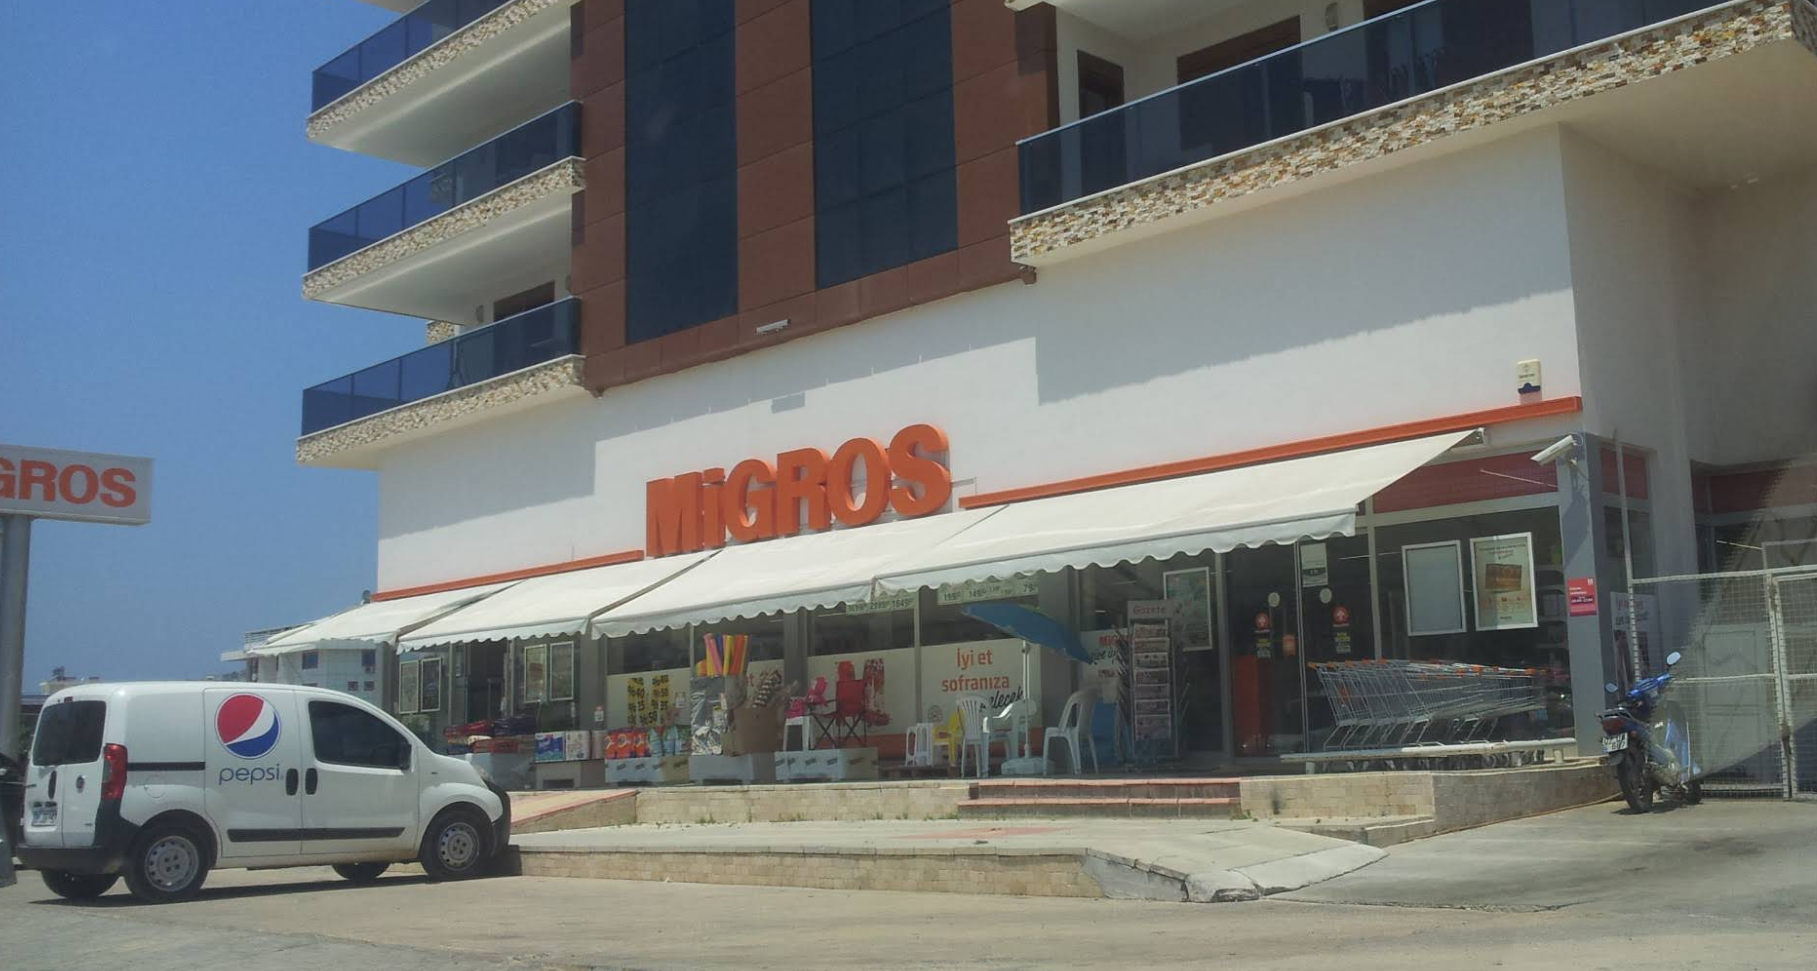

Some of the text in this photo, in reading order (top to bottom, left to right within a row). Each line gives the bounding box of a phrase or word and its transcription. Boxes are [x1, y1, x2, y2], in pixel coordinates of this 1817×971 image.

[977, 649, 993, 666] et
[941, 675, 1011, 693] sofranıza
[218, 763, 281, 786] pepsi
